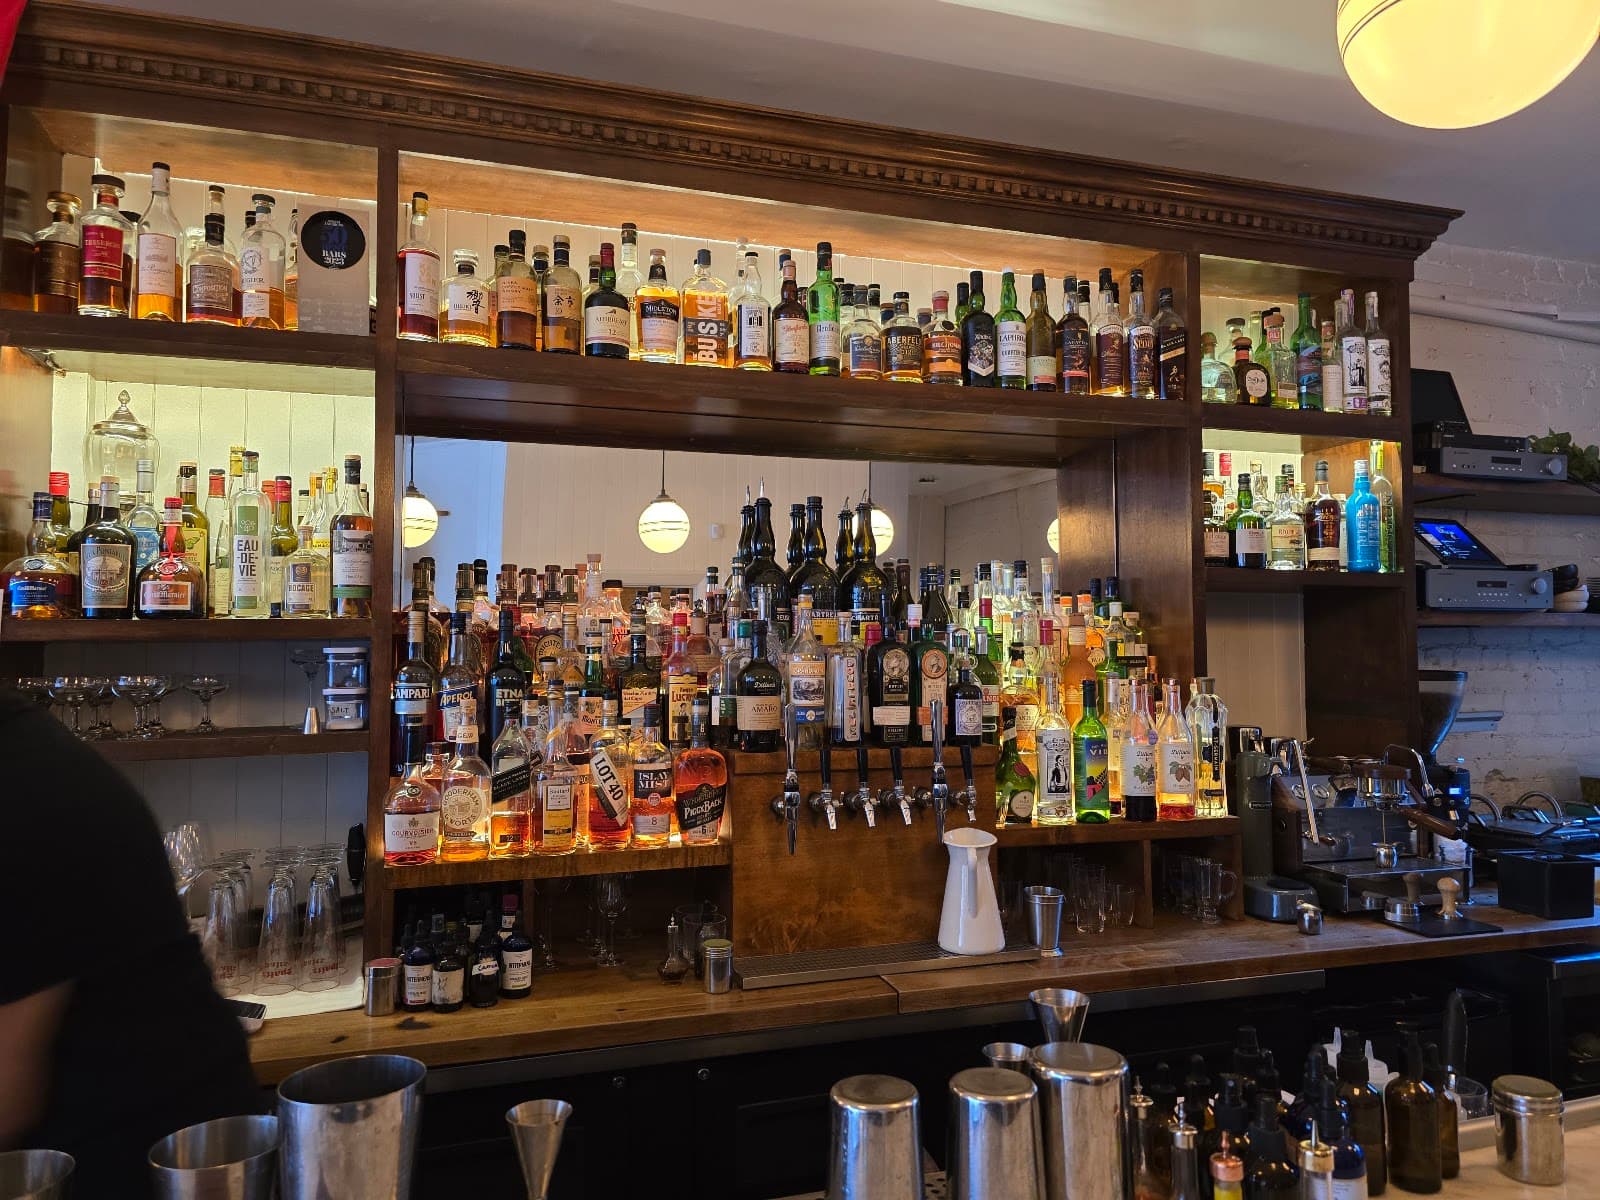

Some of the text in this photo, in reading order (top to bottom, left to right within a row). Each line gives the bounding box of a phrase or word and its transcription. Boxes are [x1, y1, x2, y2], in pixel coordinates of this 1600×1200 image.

[321, 249, 347, 258] BARS
[697, 295, 719, 363] BUSKE
[236, 540, 258, 551] EAU
[238, 565, 257, 577] VIE
[288, 583, 314, 593] BOCAGE
[394, 688, 430, 699] AMPARI
[440, 690, 473, 706] APEROL
[495, 688, 522, 698] ETNA
[331, 706, 350, 714] SALT
[751, 704, 778, 713] AMARO
[594, 757, 624, 802] LOT 40
[638, 771, 669, 781] ISLAY
[638, 780, 669, 789] MIST
[443, 788, 480, 806] GOODERHAM
[650, 816, 658, 825] 8
